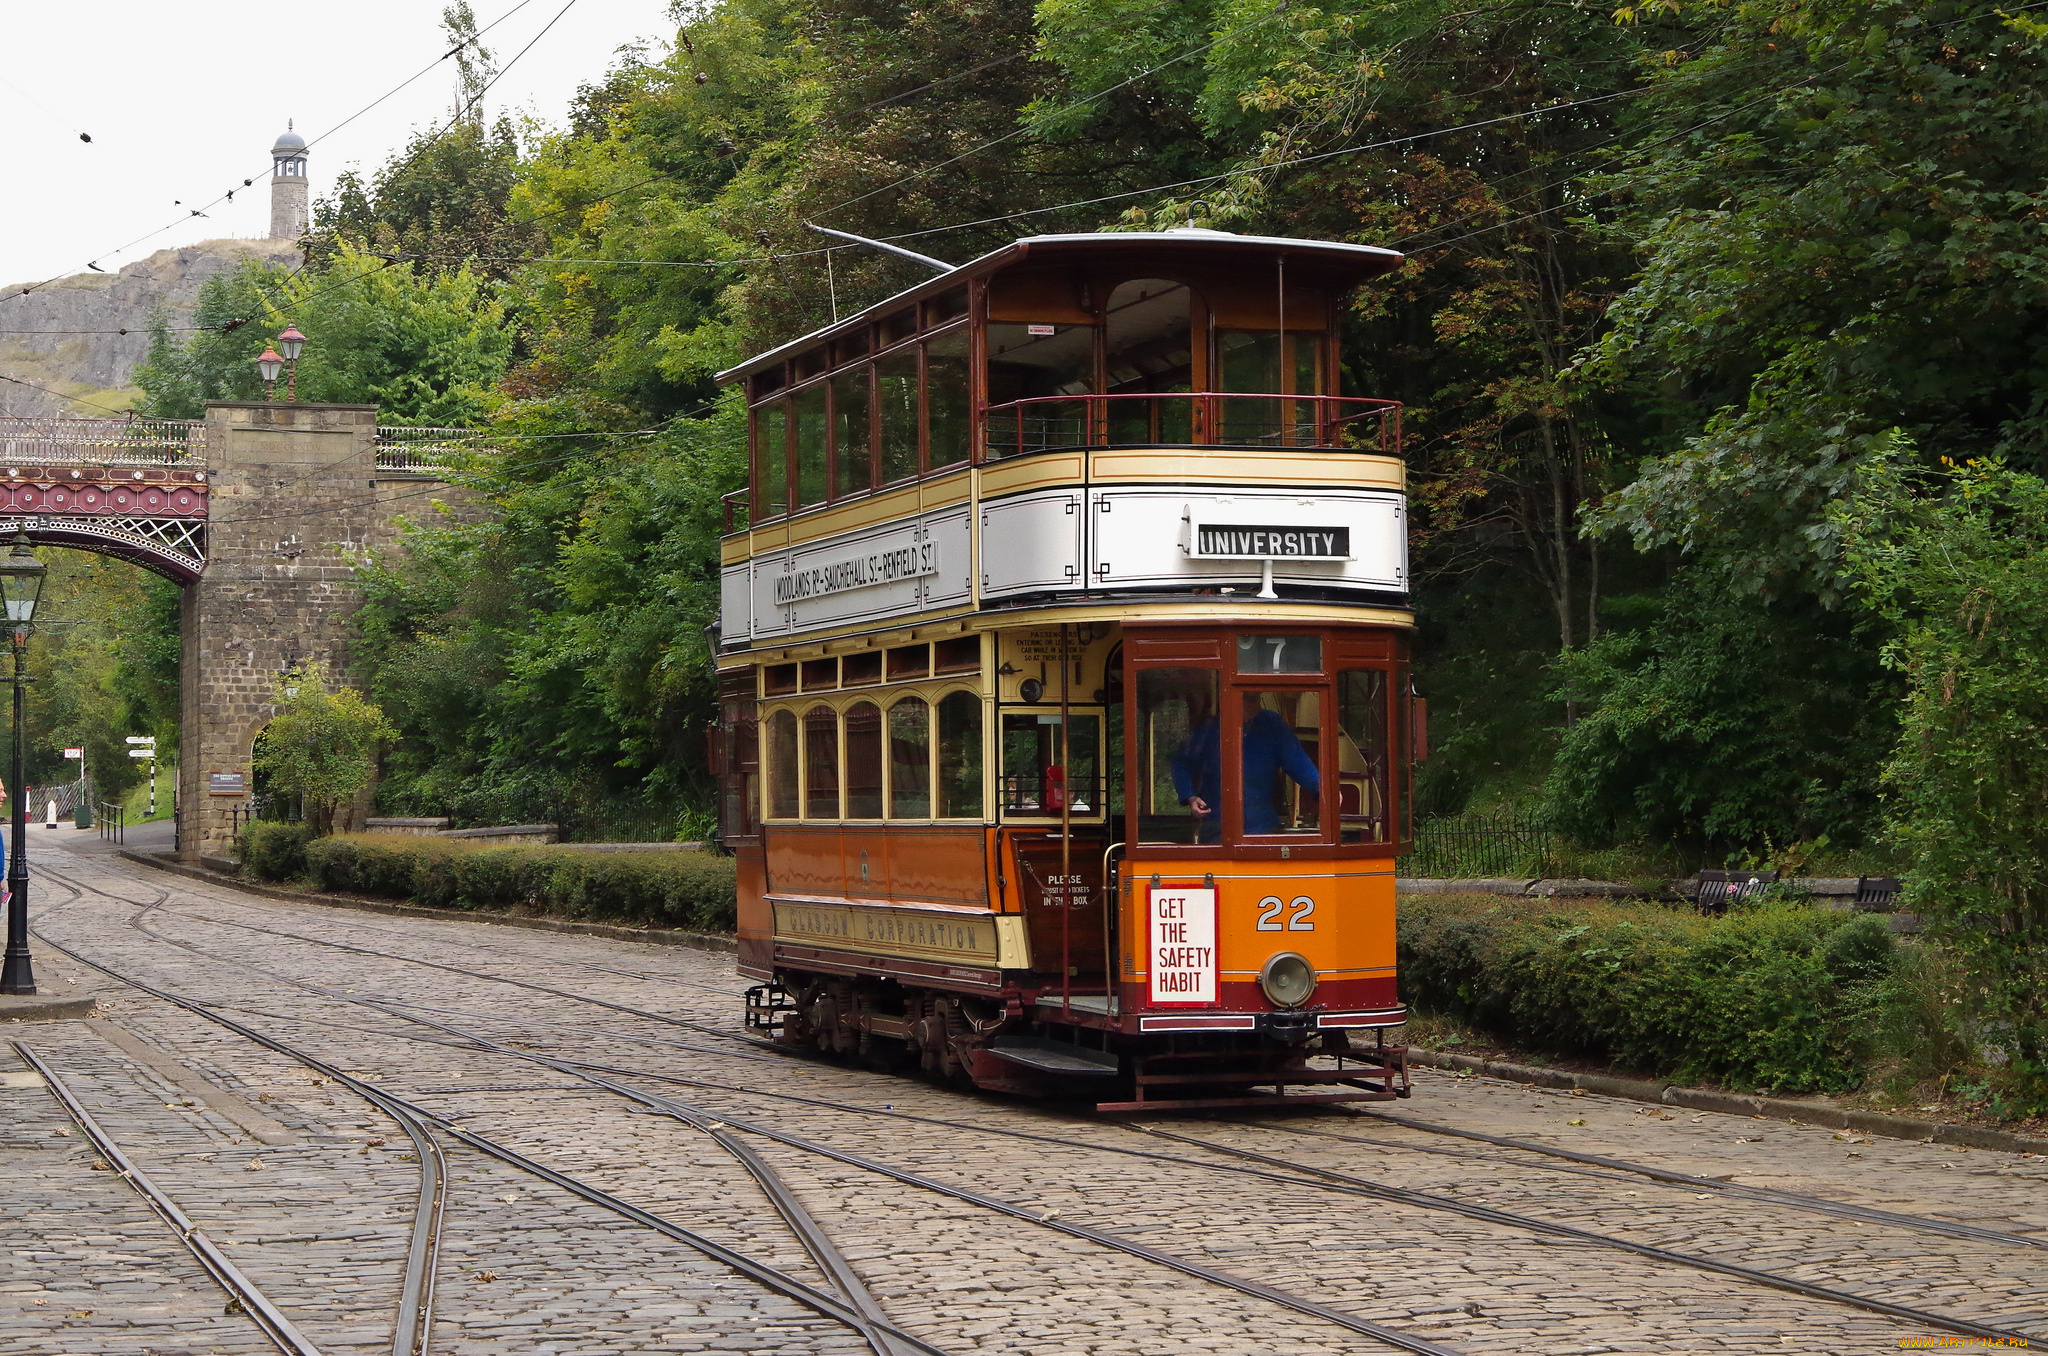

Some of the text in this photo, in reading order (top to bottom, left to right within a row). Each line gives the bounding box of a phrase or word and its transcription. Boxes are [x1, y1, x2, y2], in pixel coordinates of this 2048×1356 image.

[1199, 531, 1335, 555] UNIVERSITY
[776, 571, 811, 601] WOODLANDS
[1266, 638, 1287, 670] 7
[1048, 875, 1082, 885] PLESE
[1073, 896, 1088, 905] BOX
[1158, 897, 1186, 919] GET
[1256, 895, 1316, 932] 22
[790, 907, 976, 950] GLASGOW CORPORATION
[1159, 922, 1188, 943] THE
[1158, 947, 1212, 968] SAFETY
[1159, 972, 1202, 993] HABIT
